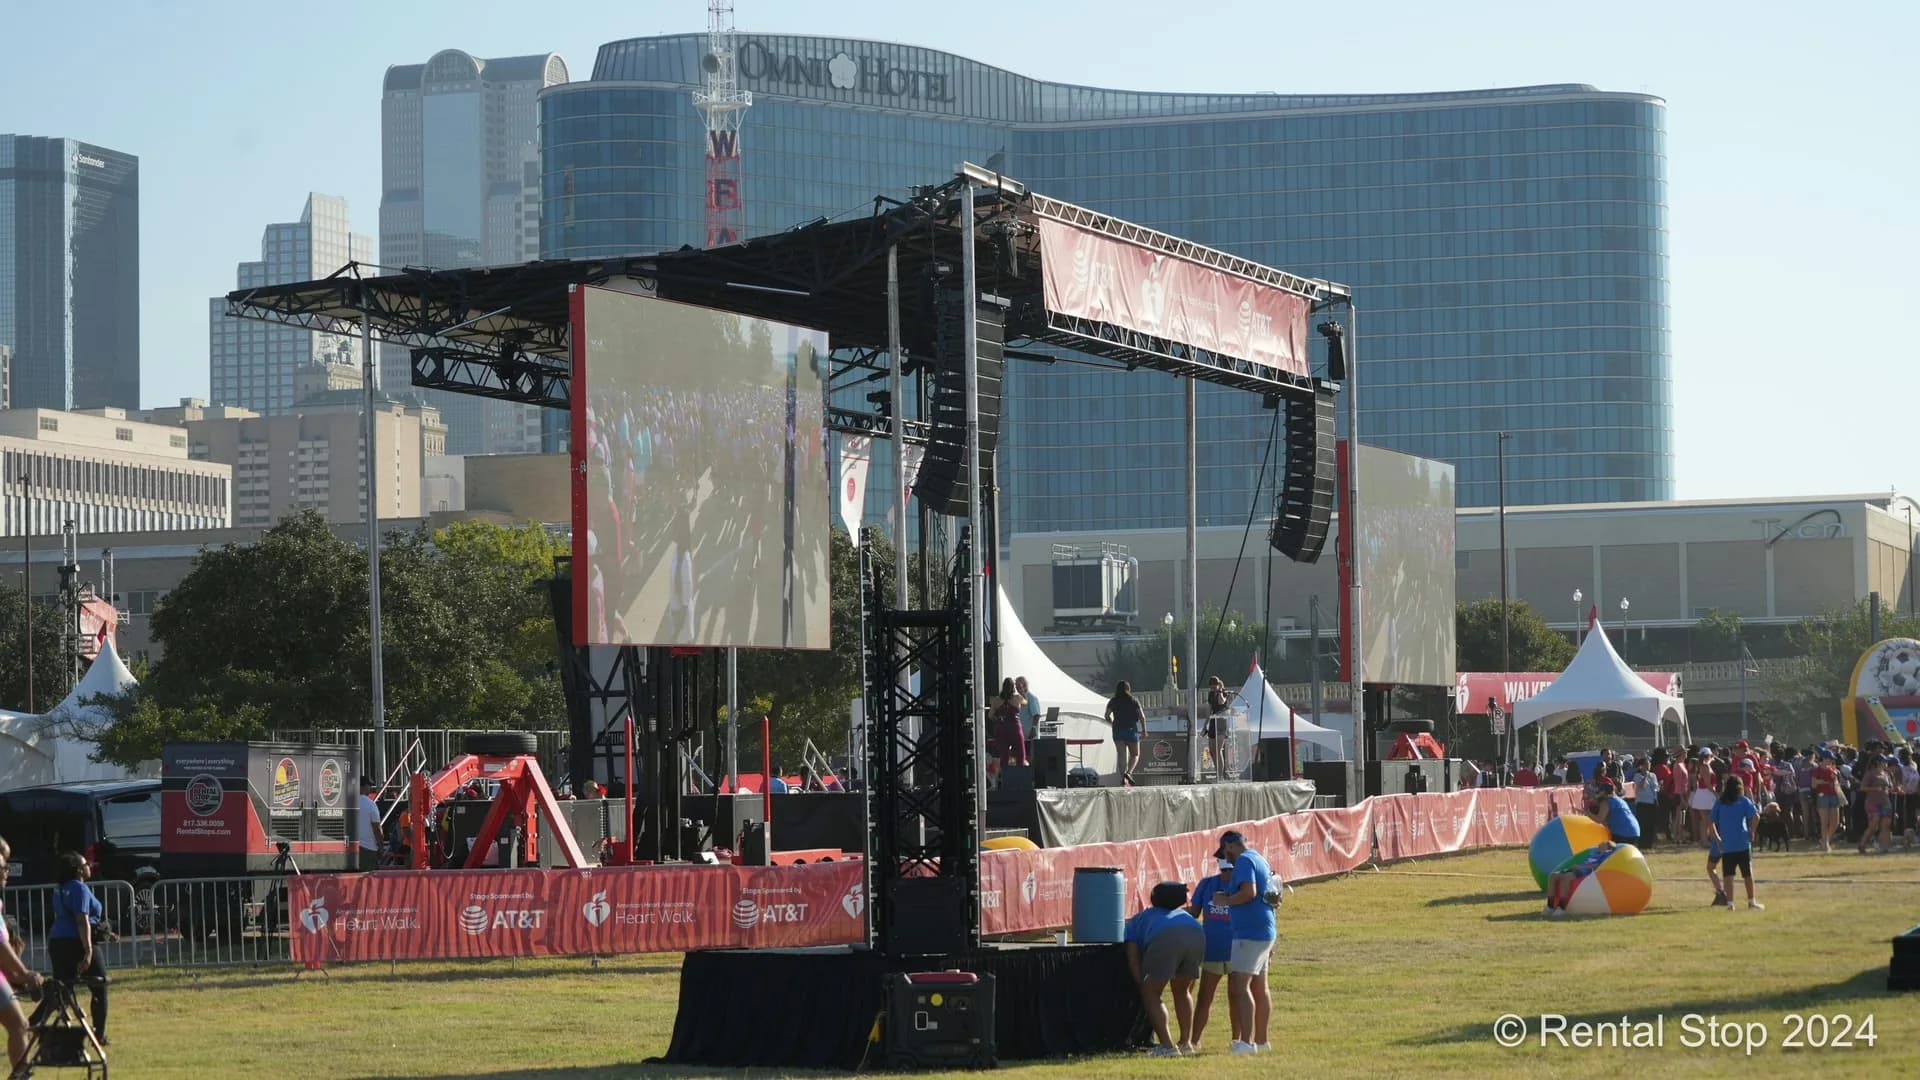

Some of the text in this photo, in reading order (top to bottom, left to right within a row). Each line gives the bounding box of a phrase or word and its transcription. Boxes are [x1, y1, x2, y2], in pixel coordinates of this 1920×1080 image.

[79, 153, 105, 169] Santander
[1504, 680, 1553, 704] WALKE
[492, 909, 545, 929] AT&T
[615, 911, 656, 925] Heart
[763, 903, 809, 923] AT&T
[335, 916, 377, 932] Heart
